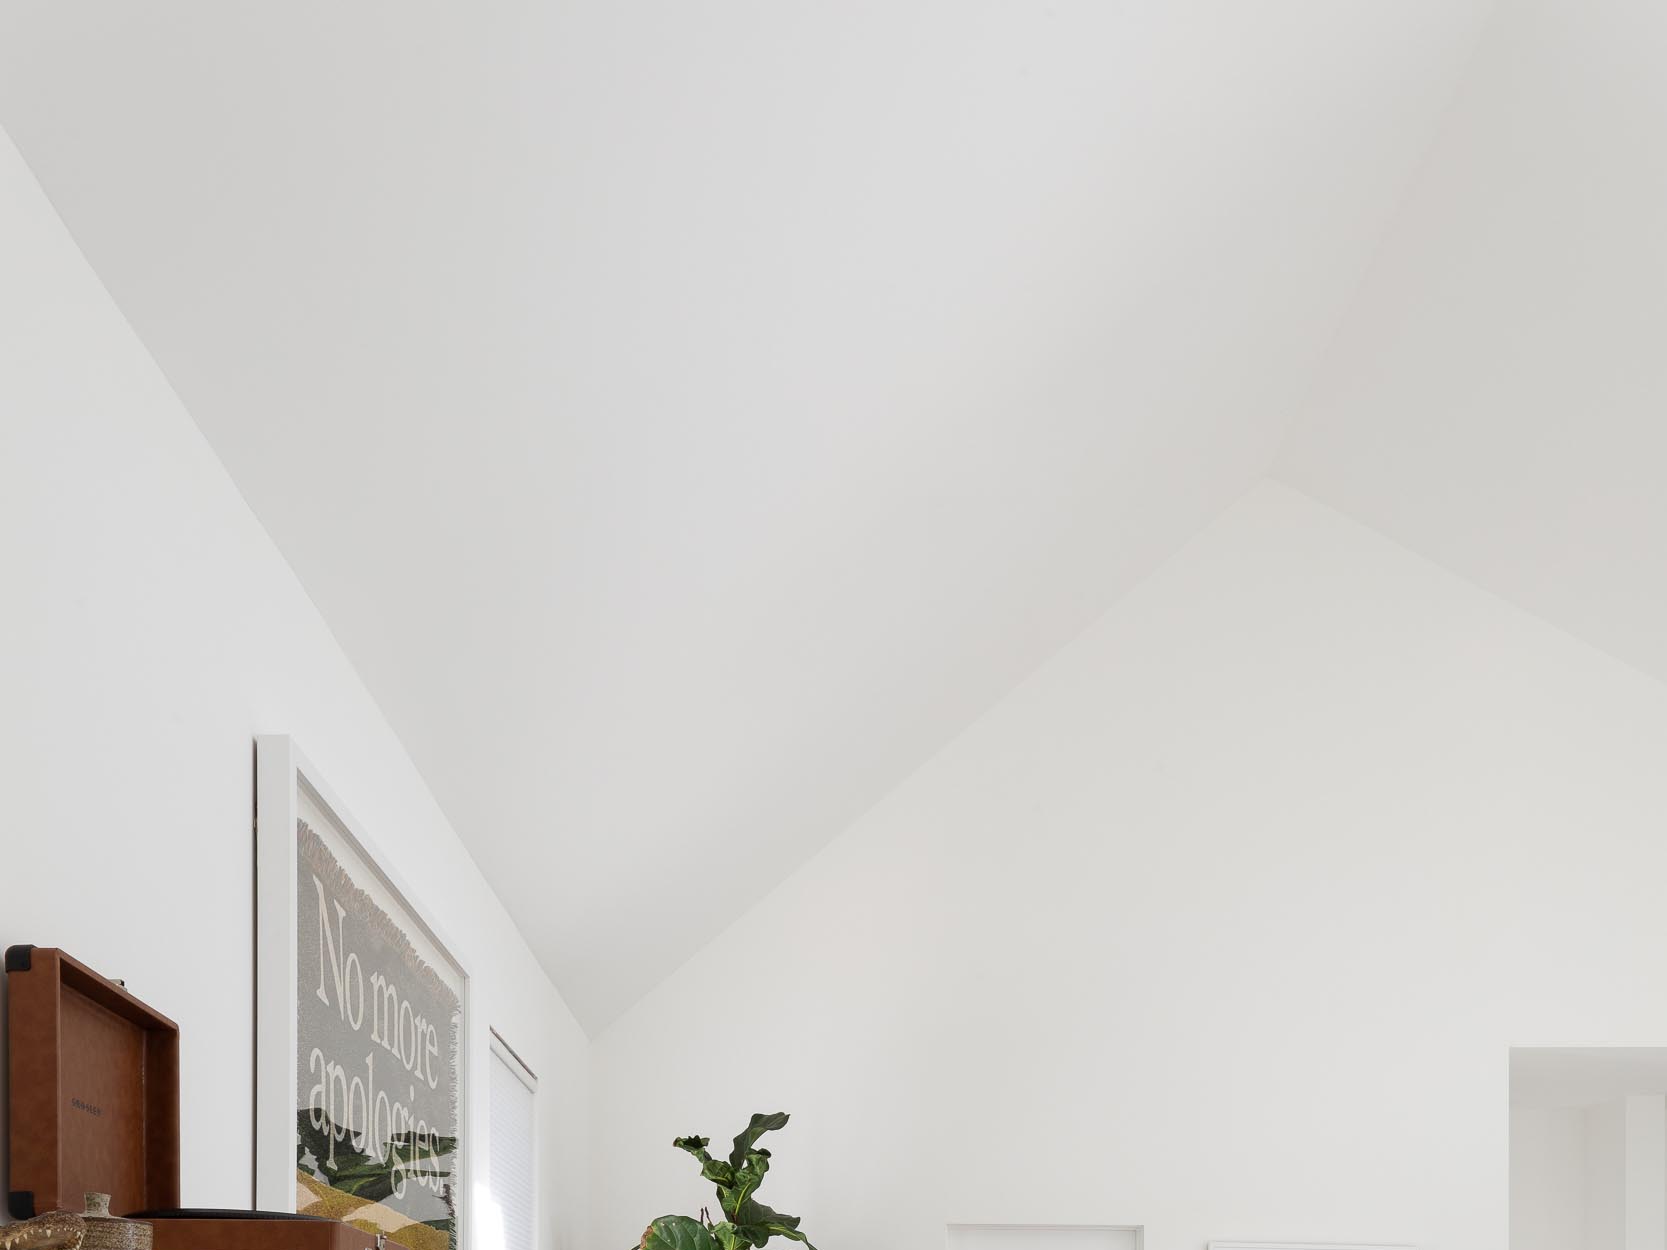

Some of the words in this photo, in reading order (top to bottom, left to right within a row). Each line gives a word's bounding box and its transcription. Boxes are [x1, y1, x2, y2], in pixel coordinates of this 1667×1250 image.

[312, 874, 364, 1031] No
[370, 971, 439, 1089] more
[309, 1047, 444, 1200] apologies.
